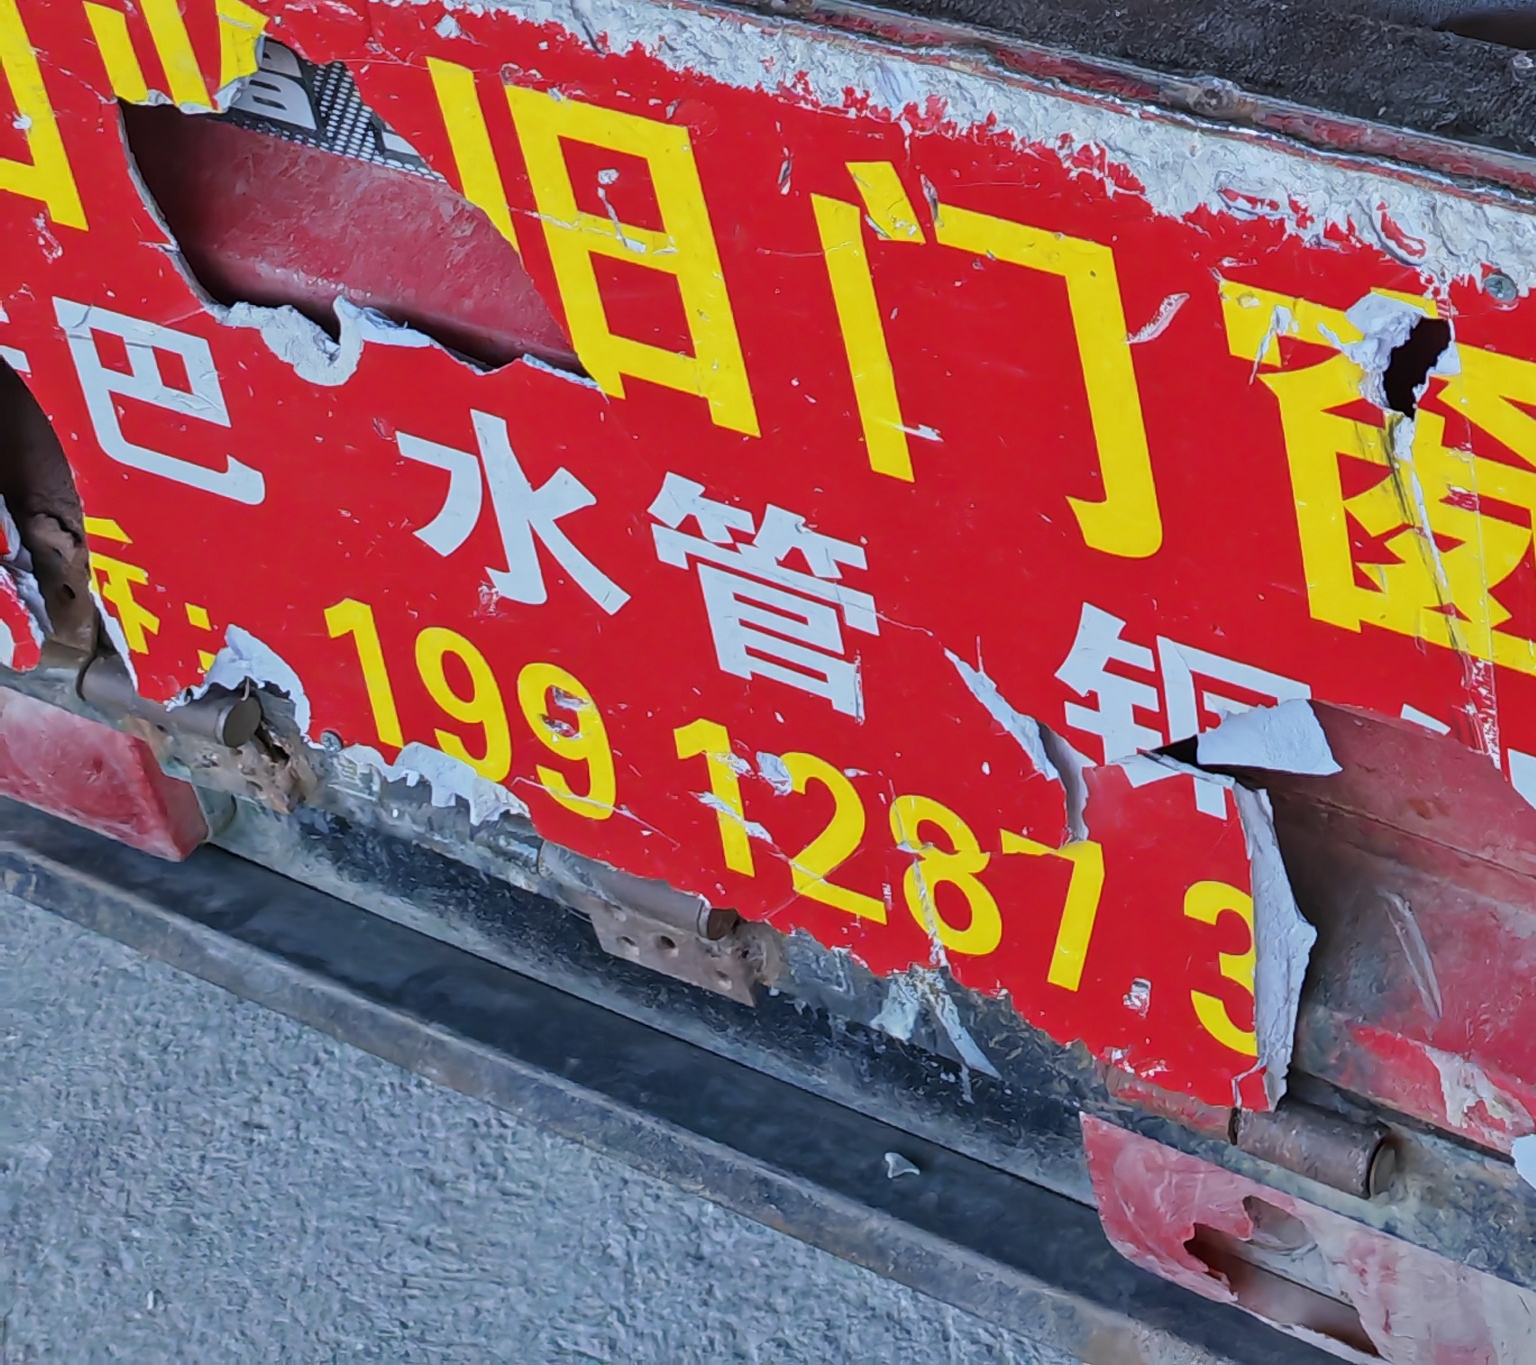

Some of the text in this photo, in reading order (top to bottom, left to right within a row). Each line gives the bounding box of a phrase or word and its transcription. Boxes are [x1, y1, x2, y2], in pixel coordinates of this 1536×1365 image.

[0, 279, 266, 507] 巴
[395, 409, 880, 723] 水管
[323, 597, 616, 821] 199
[673, 717, 1106, 992] 1287
